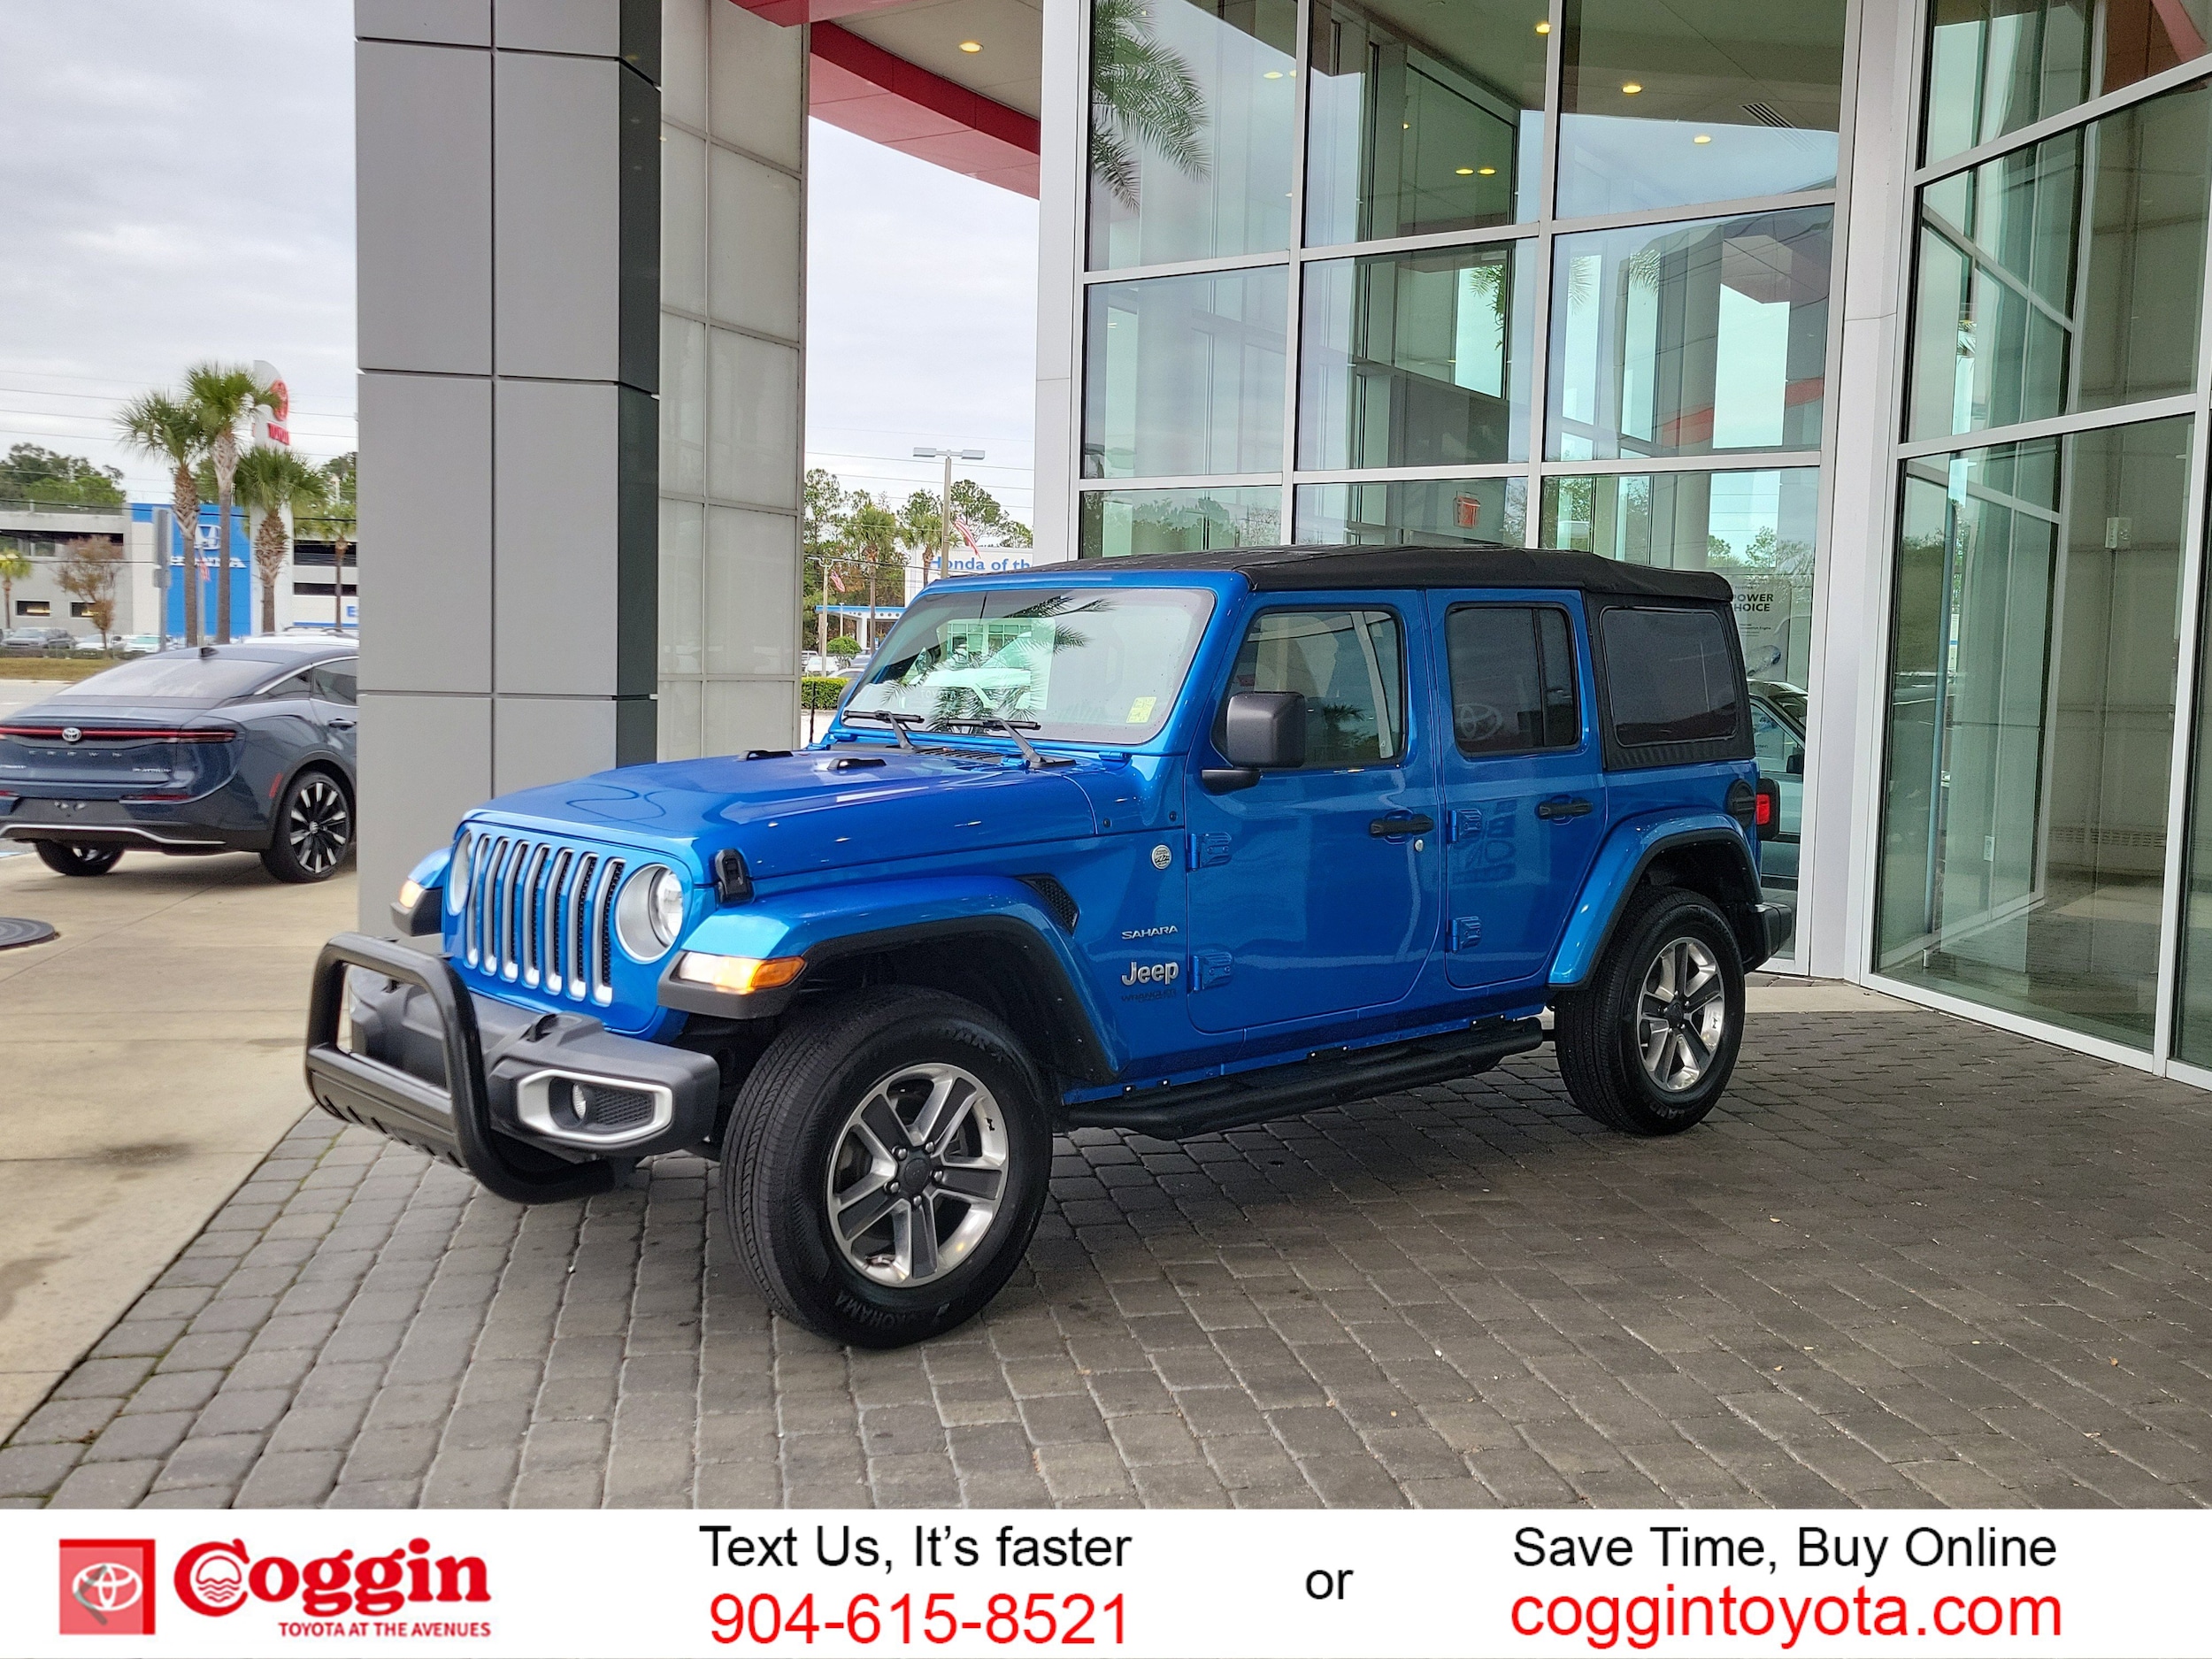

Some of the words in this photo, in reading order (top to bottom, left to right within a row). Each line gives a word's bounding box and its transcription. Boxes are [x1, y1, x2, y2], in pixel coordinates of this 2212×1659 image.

[169, 556, 247, 567] HNDA
[991, 558, 1009, 571] of
[1121, 925, 1179, 940] SAHARA
[1121, 961, 1179, 986] Jeep
